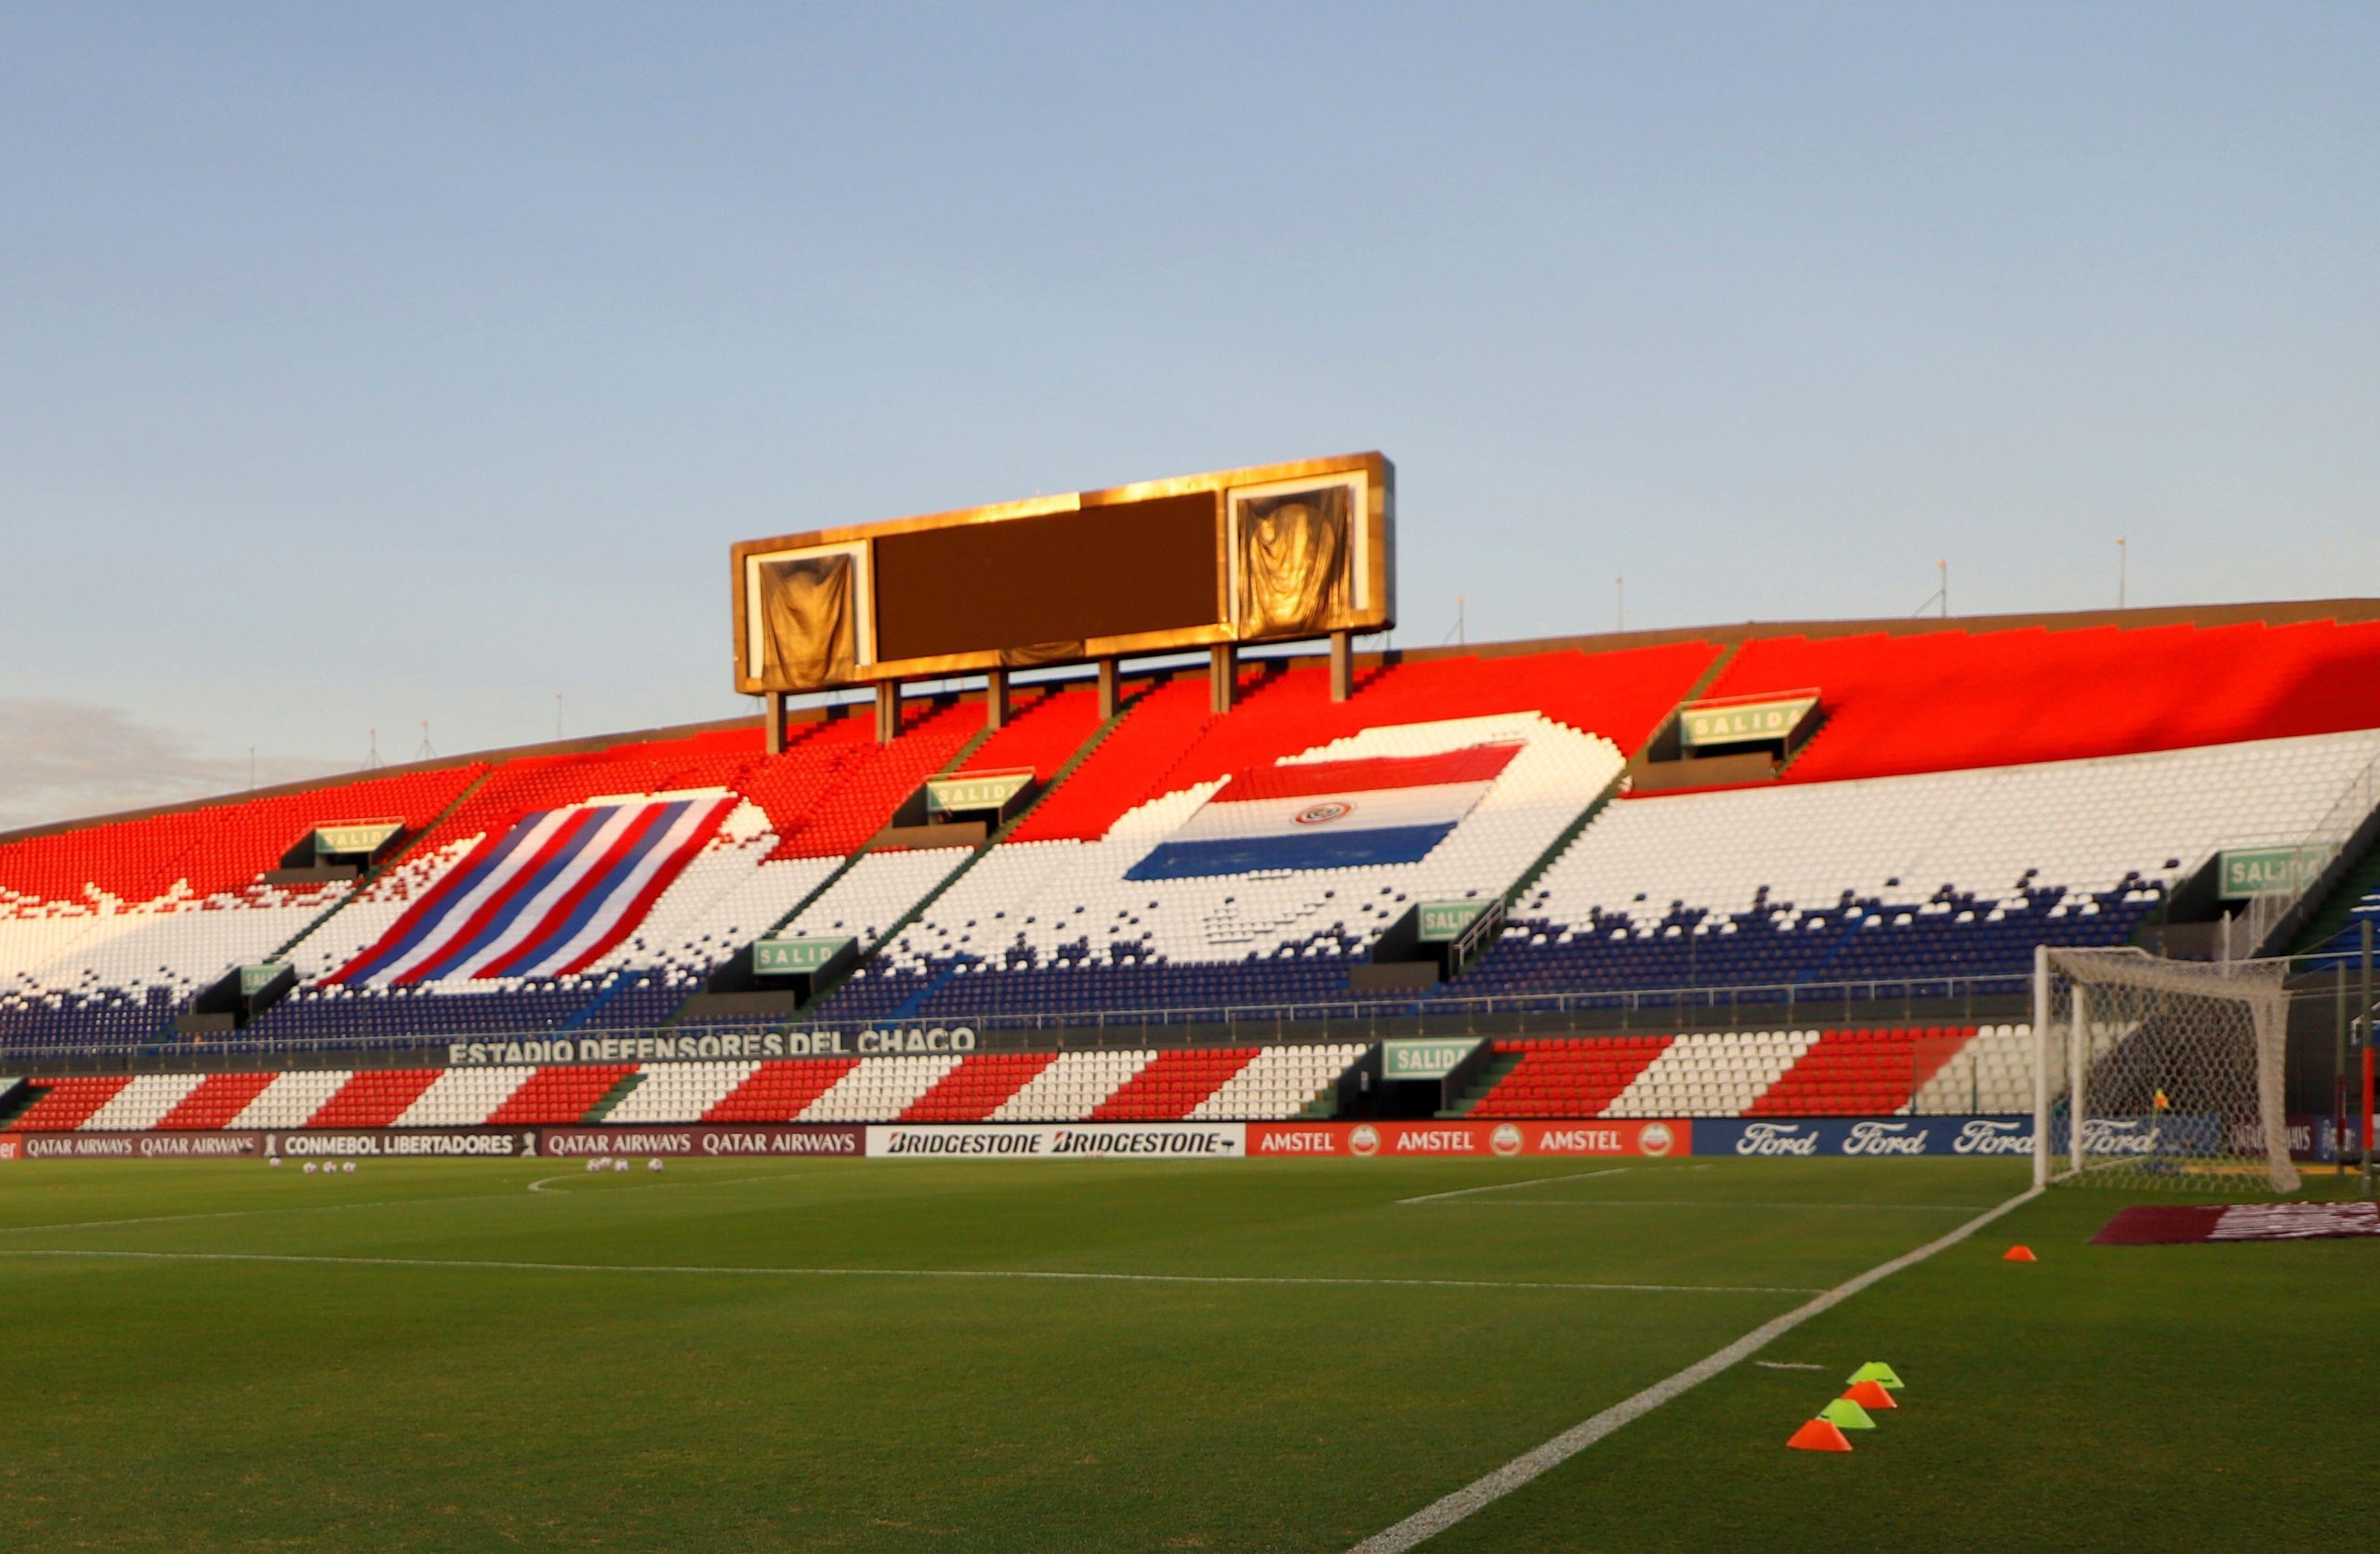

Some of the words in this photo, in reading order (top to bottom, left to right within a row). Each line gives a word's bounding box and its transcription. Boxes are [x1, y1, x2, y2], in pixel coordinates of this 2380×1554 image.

[760, 946, 833, 964] SALID
[449, 1039, 575, 1063] ESTADIO
[580, 1034, 784, 1060] DEFENSORES
[791, 1031, 851, 1056] DEL
[857, 1027, 975, 1053] CHACO
[27, 1139, 73, 1157] QATAR
[74, 1138, 133, 1153] AIRWAYS
[140, 1138, 189, 1157] QATAR
[284, 1136, 380, 1155] CONMEBOL
[384, 1135, 513, 1154] LIBERTADORES
[549, 1134, 609, 1156] QATAR
[612, 1133, 691, 1152] AIRWAYS
[702, 1133, 767, 1155] QATAR
[771, 1132, 855, 1152] AIRWAYS
[887, 1132, 1042, 1153] BRIDGESTONE
[1051, 1130, 1221, 1152] BRIDGESTONE
[1261, 1132, 1334, 1152] AMSTEL
[1396, 1131, 1474, 1151] AMSTEL
[1539, 1130, 1621, 1151] AMSTEL
[1736, 1122, 1819, 1155] Ford
[1842, 1121, 1929, 1155] Ford
